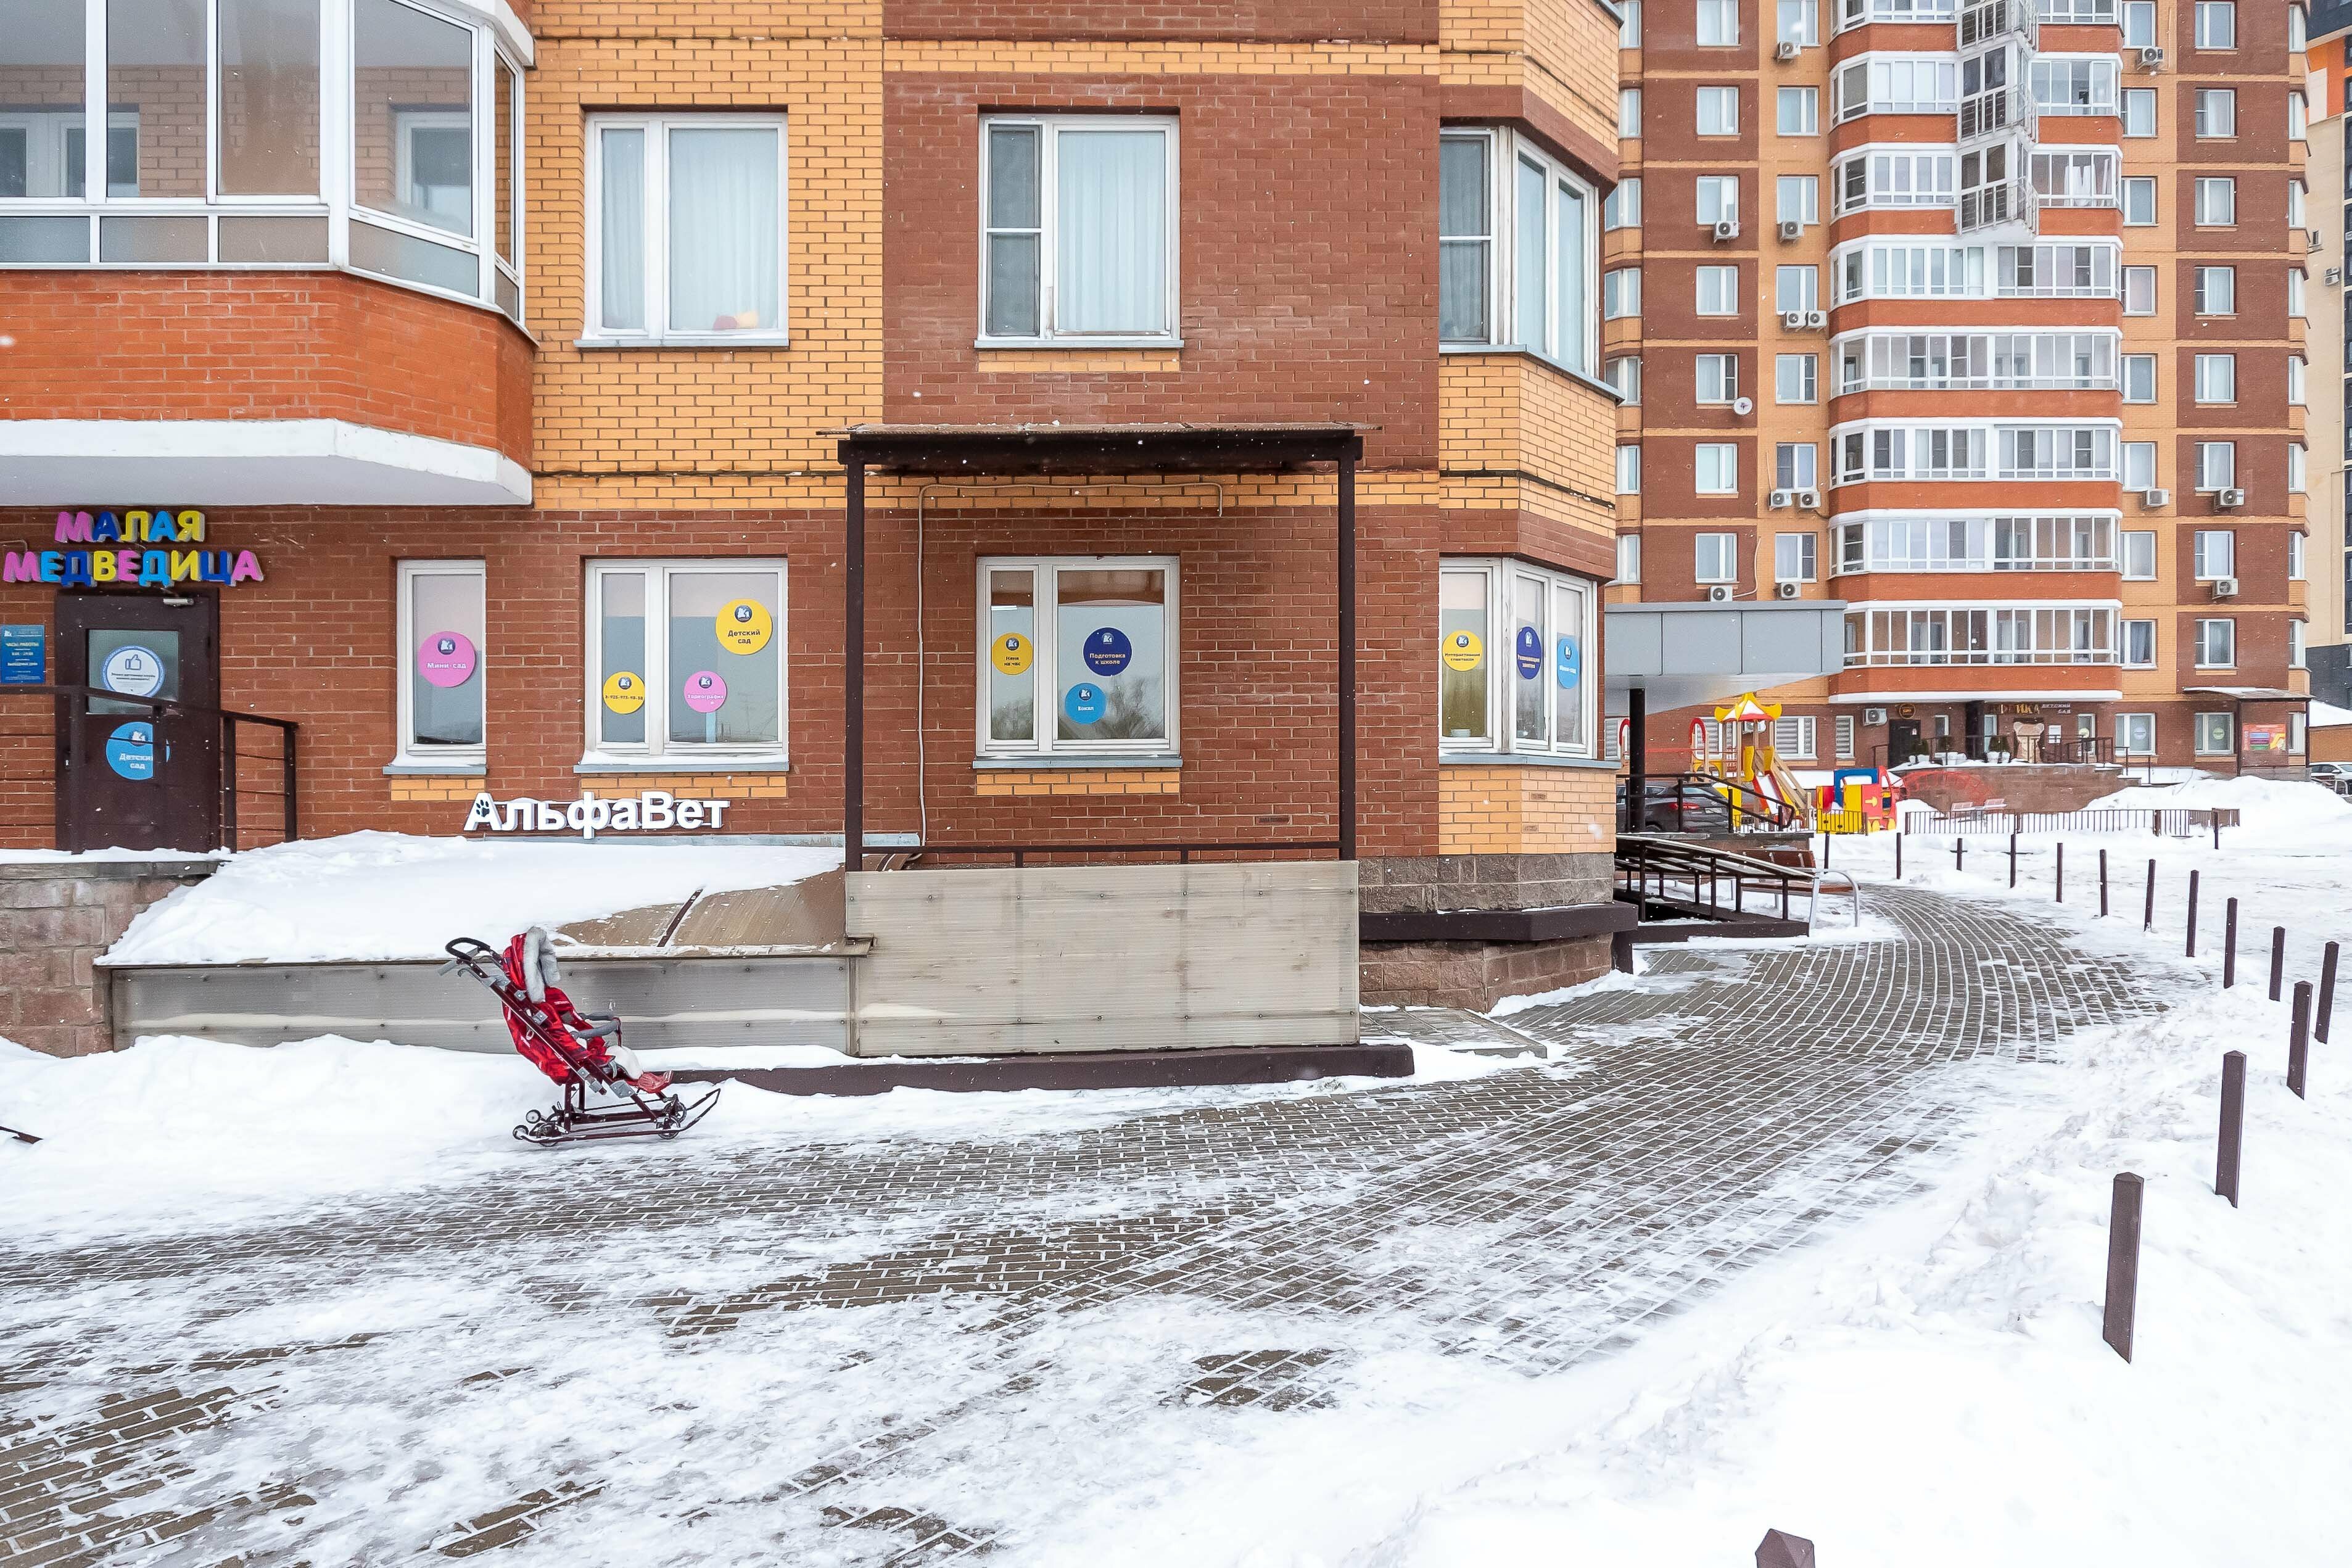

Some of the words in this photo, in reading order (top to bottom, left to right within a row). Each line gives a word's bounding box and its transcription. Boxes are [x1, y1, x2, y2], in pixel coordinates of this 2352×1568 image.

[54, 510, 205, 543] МАЛАЯ
[2, 550, 264, 587] МЕДВЕДИЦА
[463, 791, 731, 840] АльфаВет
